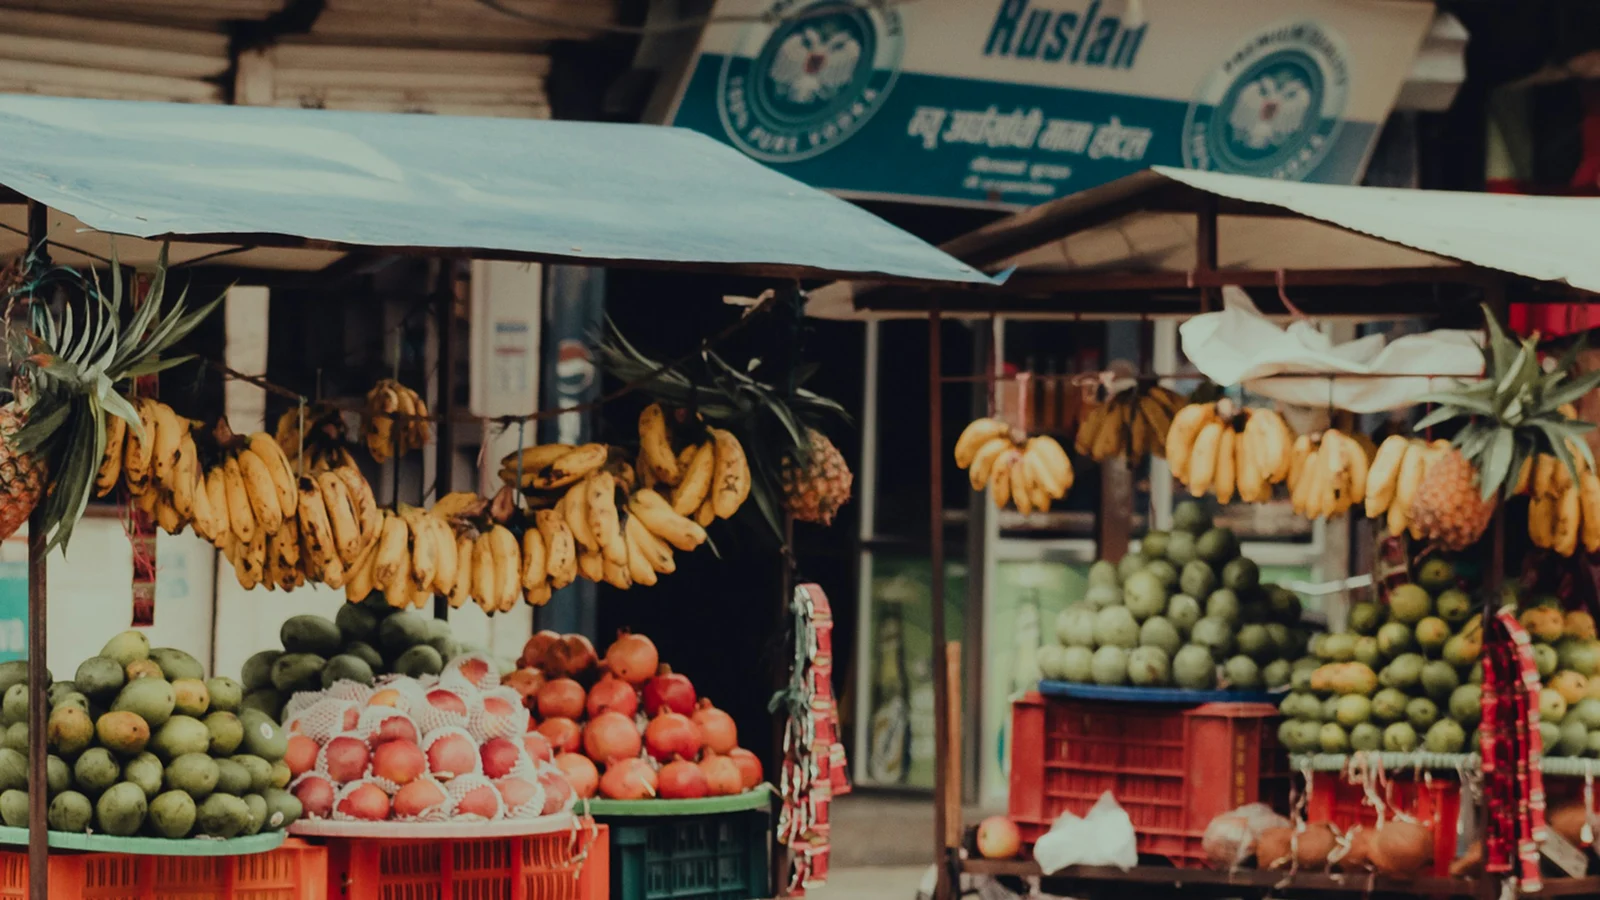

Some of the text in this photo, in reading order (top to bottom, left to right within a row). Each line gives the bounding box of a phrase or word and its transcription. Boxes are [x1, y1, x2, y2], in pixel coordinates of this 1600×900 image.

[983, 0, 1148, 69] Ruslan
[748, 126, 799, 152] PURE
[808, 88, 878, 146] VODKA
